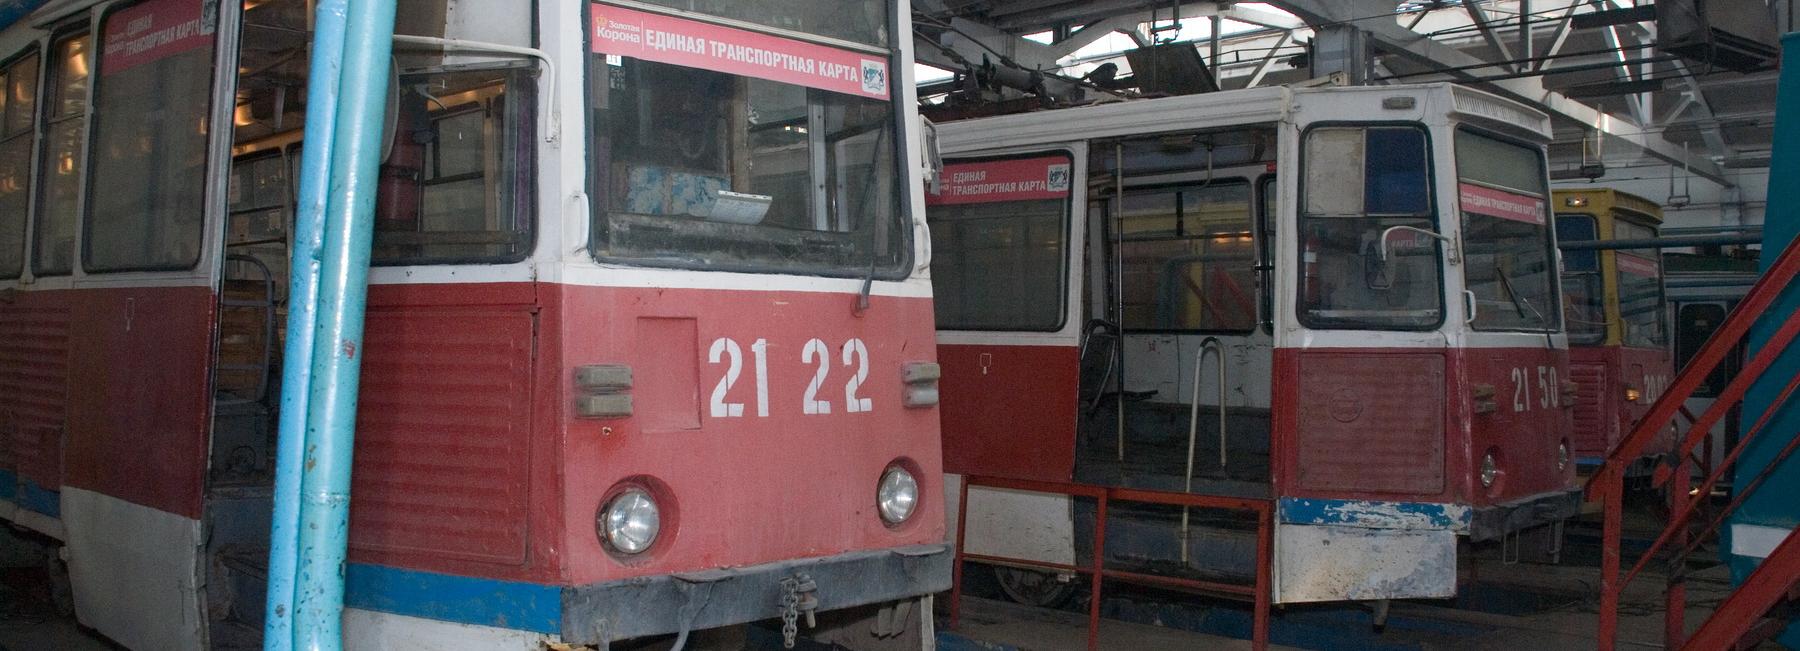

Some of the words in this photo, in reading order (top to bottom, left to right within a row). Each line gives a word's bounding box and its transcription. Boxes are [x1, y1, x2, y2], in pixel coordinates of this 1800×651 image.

[176, 18, 200, 40] КАРТА
[597, 26, 640, 43] Корона
[608, 20, 640, 32] Золотая
[646, 29, 705, 54] ЕДИНАЯ
[709, 40, 815, 75] ТРАНСПОРТНАЯ
[819, 60, 858, 82] КАРТА
[953, 170, 986, 184] ЕДИНАЯ
[952, 181, 1017, 196] ТРАНСПОРТНАЯ
[1018, 180, 1046, 192] КАРТА
[708, 337, 769, 417] 21
[801, 338, 872, 414] 22
[1511, 366, 1530, 412] 21
[1537, 366, 1558, 409] 50
